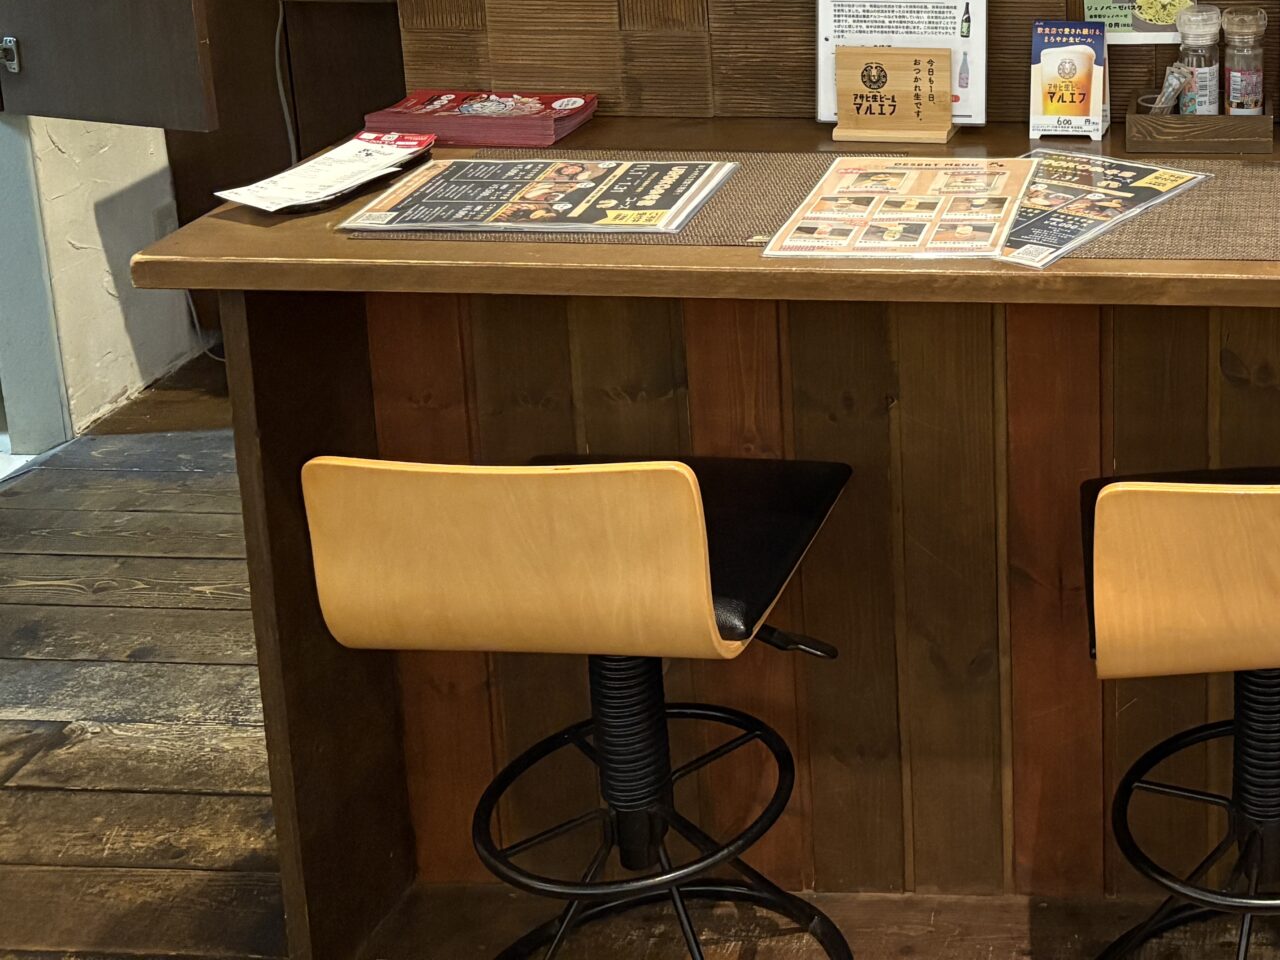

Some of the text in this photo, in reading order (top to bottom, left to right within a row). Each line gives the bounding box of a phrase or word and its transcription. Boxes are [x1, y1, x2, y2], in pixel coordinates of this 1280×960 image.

[913, 59, 922, 121] おつかれ生です。
[853, 93, 897, 103] アサヒ生ビール
[1047, 92, 1087, 103] マルエフ
[853, 103, 897, 115] マルエフ
